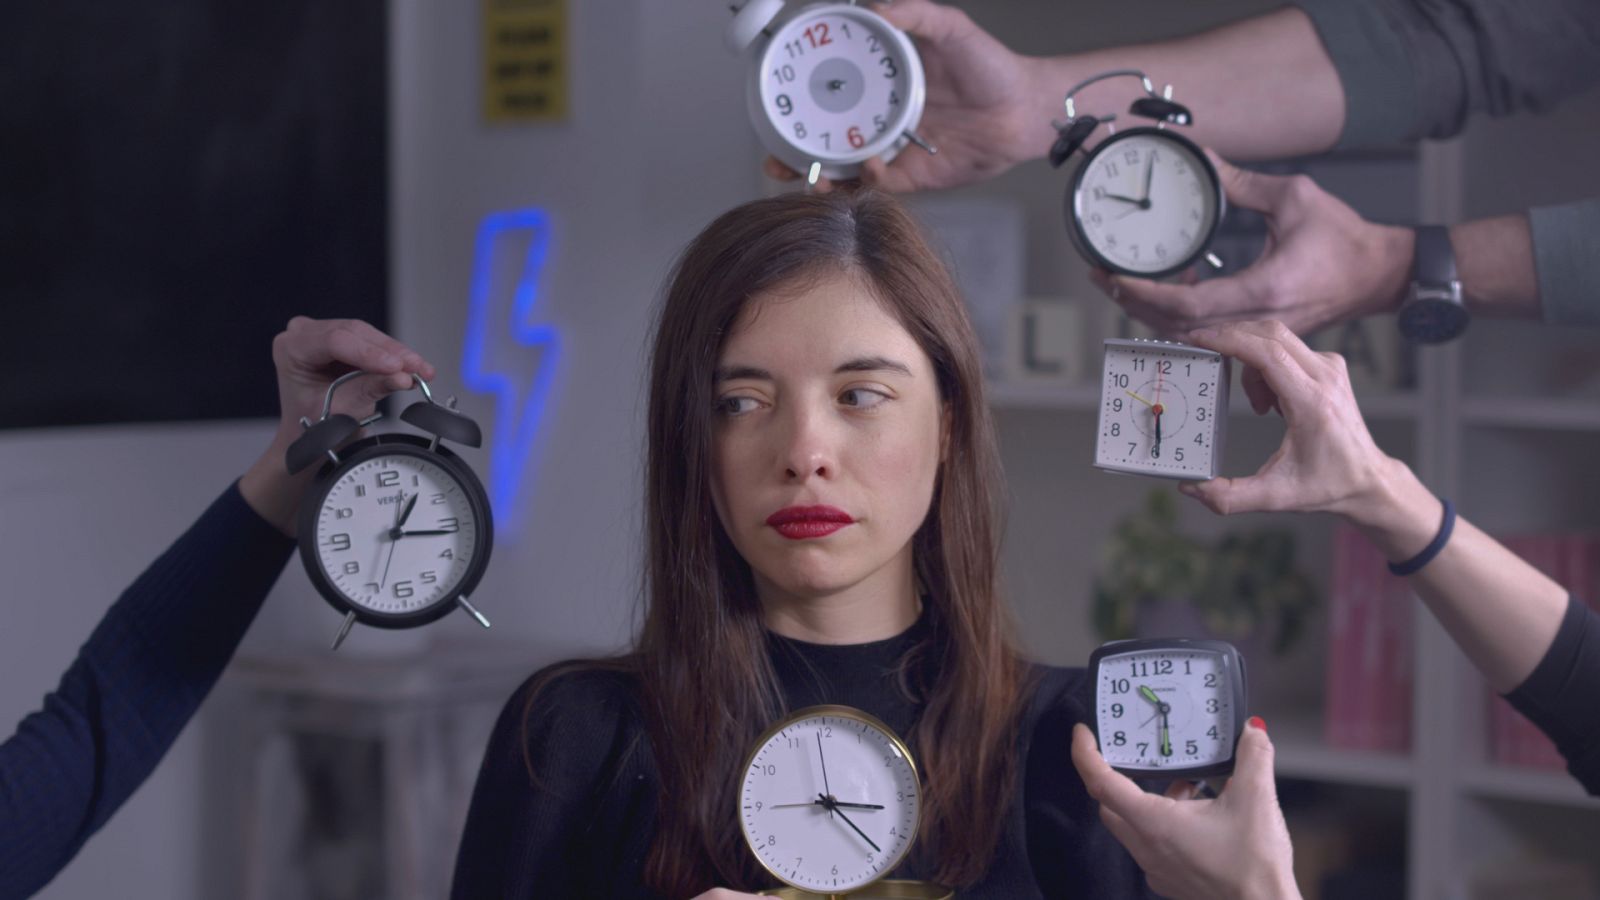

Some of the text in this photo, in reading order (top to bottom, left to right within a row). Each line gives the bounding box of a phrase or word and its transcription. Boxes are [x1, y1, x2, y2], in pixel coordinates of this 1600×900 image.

[803, 22, 832, 48] 12
[841, 24, 851, 39] 1
[785, 40, 804, 58] 11
[866, 36, 881, 53] 2
[880, 56, 897, 78] 3
[773, 65, 795, 84] 10
[776, 94, 792, 115] 9
[793, 122, 807, 139] 8
[873, 115, 886, 133] 5
[819, 132, 831, 149] 7
[847, 126, 864, 148] 6
[1023, 315, 1062, 373] L
[1132, 358, 1144, 371] 11
[1156, 361, 1172, 374] 12
[1186, 363, 1191, 376] 1
[1113, 374, 1128, 388] 10
[1198, 383, 1208, 396] 2
[1113, 398, 1122, 412] 9
[1196, 407, 1206, 421] 3
[1111, 423, 1120, 437] 8
[1194, 433, 1203, 446] 4
[1128, 442, 1137, 456] 7
[1151, 445, 1159, 459] 6
[1175, 448, 1184, 461] 5
[375, 471, 399, 487] 12
[412, 475, 419, 486] 1
[355, 485, 365, 497] 11
[431, 493, 445, 505] 2
[336, 508, 352, 519] 10
[438, 518, 460, 533] 3
[331, 533, 351, 551] 9
[439, 549, 453, 560] 4
[345, 561, 359, 574] 8
[421, 571, 436, 584] 5
[365, 583, 380, 594] 7
[393, 581, 414, 598] 6
[1131, 661, 1148, 677] 11
[1152, 660, 1173, 675] 12
[1184, 660, 1192, 675] 1
[1111, 679, 1129, 694] 10
[1204, 674, 1216, 687] 2
[1111, 703, 1124, 718] 9
[1206, 699, 1219, 713] 3
[819, 728, 832, 737] 12
[857, 735, 861, 744] 1
[1113, 731, 1126, 746] 8
[1206, 725, 1218, 740] 4
[788, 739, 798, 748] 11
[1136, 743, 1148, 757] 7
[1161, 742, 1173, 757] 6
[1186, 740, 1198, 755] 5
[885, 756, 891, 767] 2
[763, 765, 775, 776] 10
[897, 792, 903, 801] 3
[756, 802, 762, 811] 9
[889, 827, 896, 835] 4
[769, 836, 775, 845] 8
[795, 858, 802, 867] 7
[867, 853, 873, 863] 5
[832, 865, 838, 875] 6
